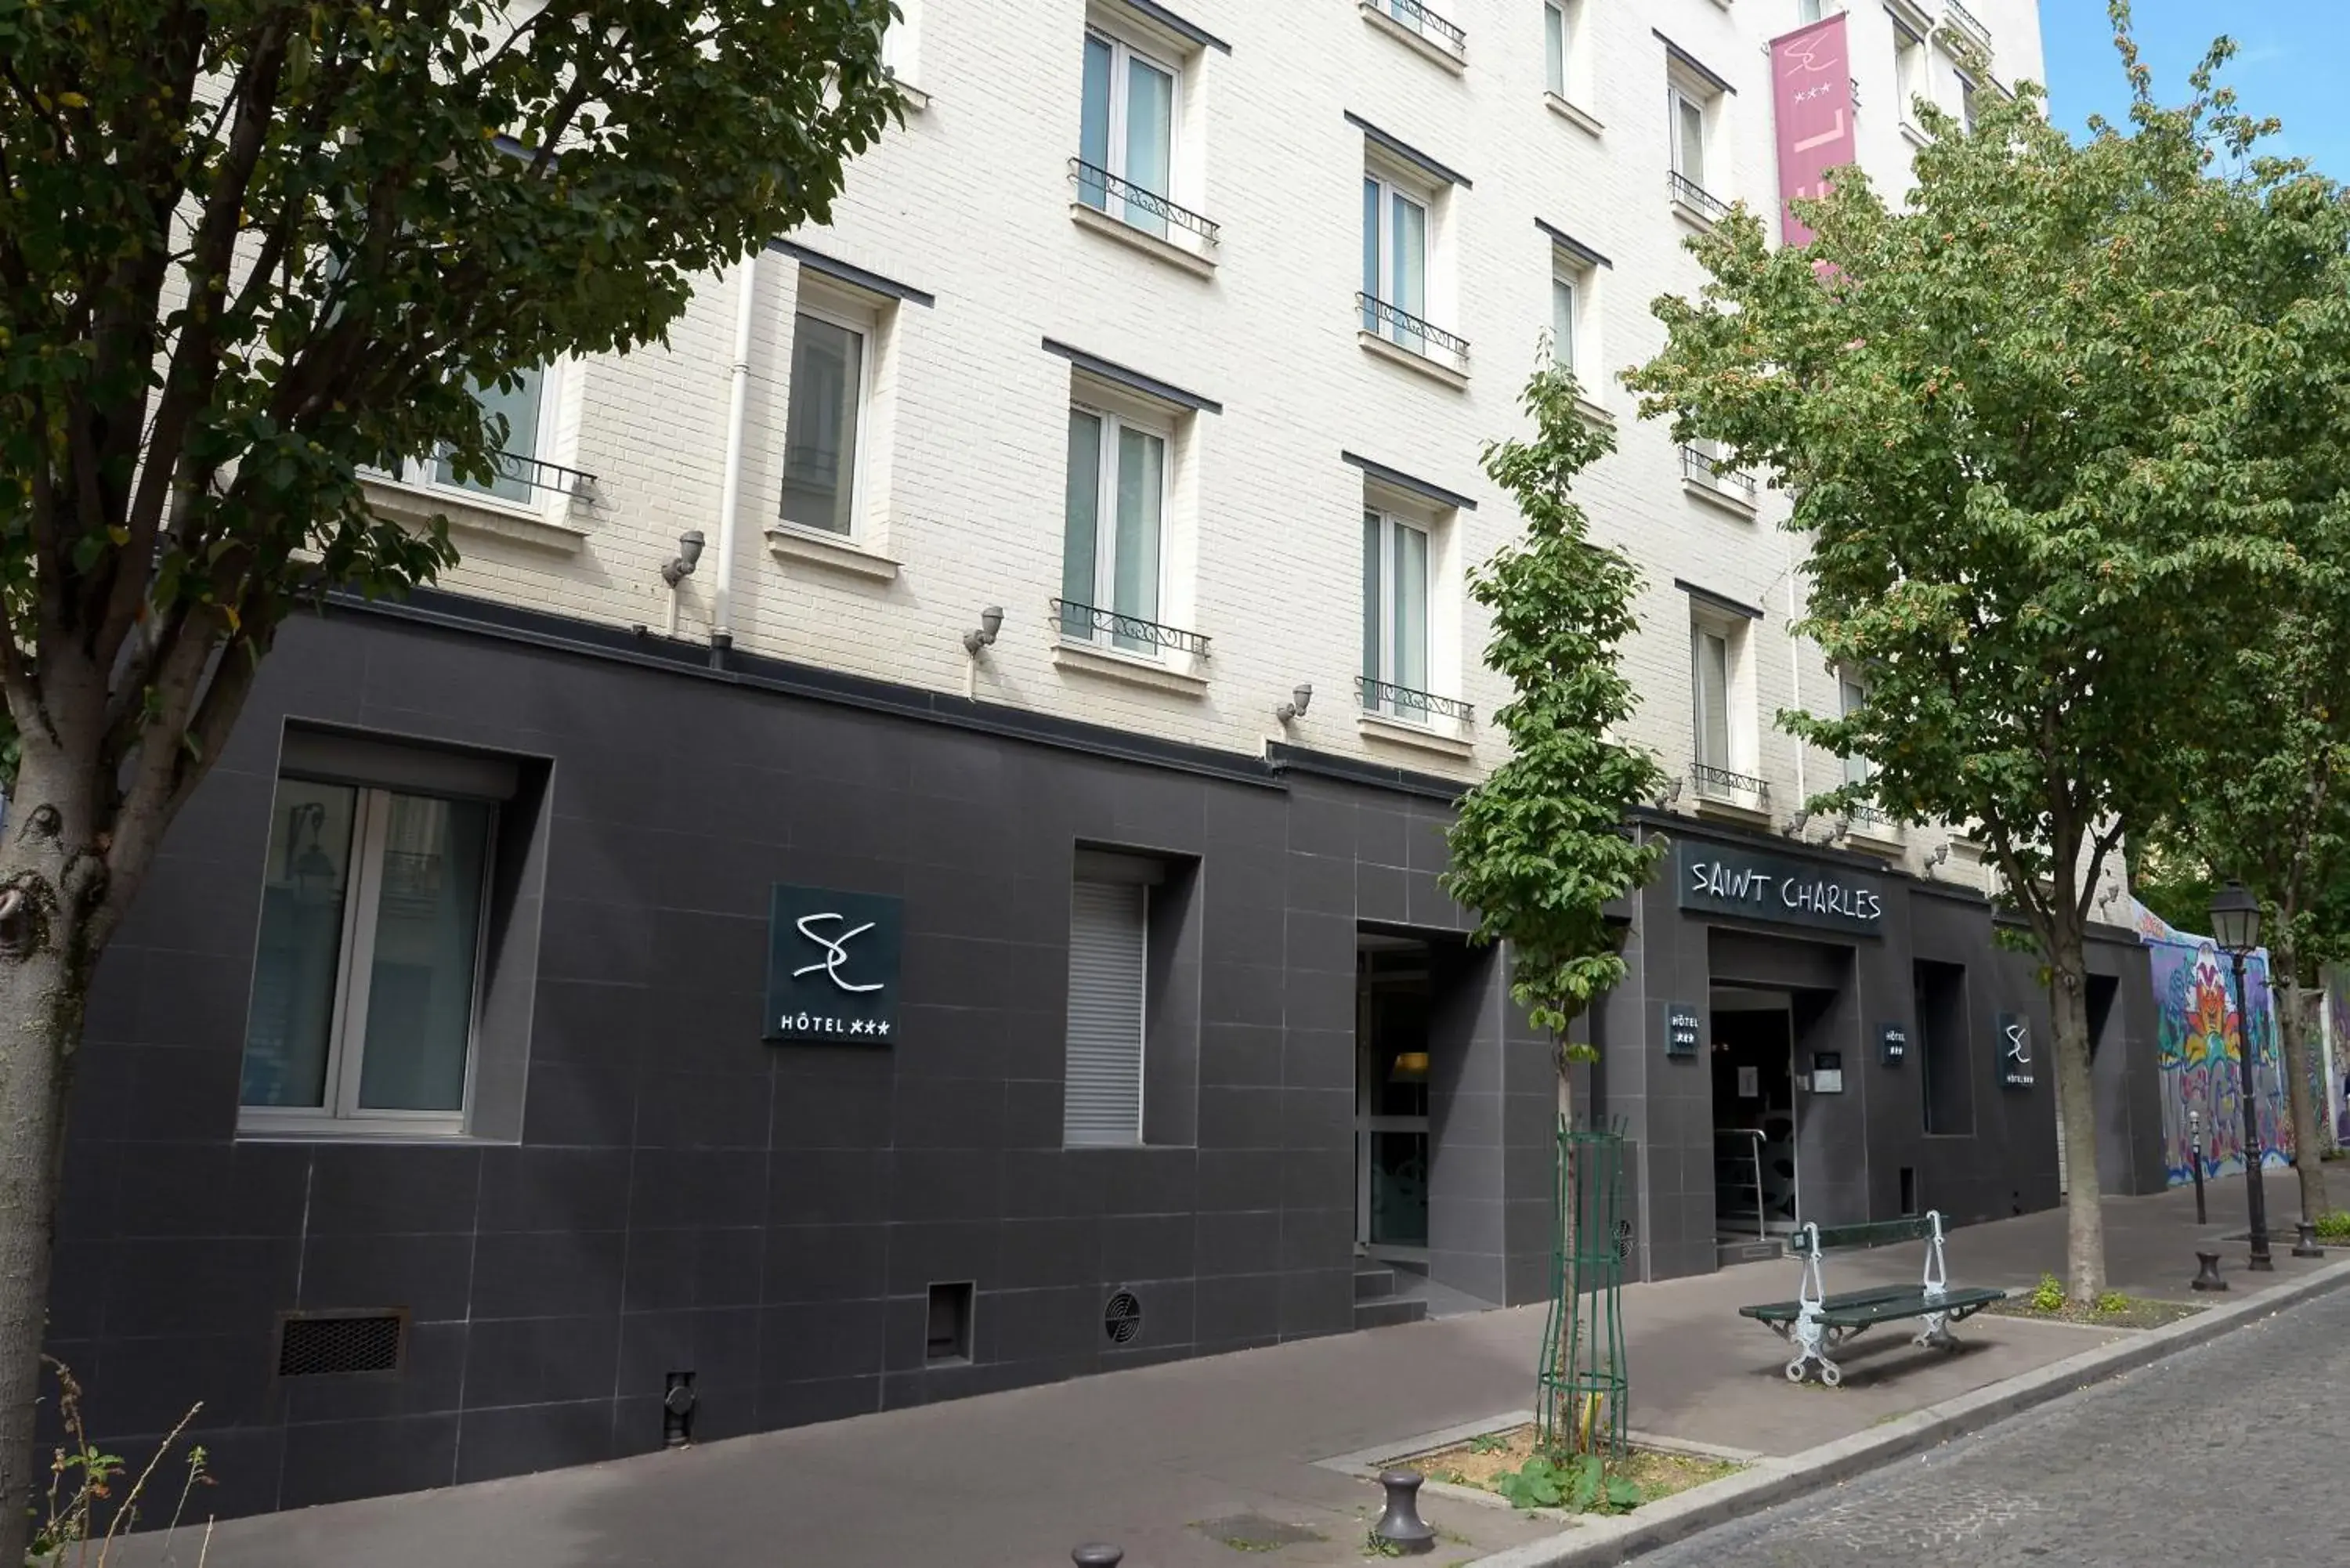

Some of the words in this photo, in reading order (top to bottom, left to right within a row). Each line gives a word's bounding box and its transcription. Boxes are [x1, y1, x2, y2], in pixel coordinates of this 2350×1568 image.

[1690, 862, 1772, 901] SAINT
[1781, 877, 1882, 919] CHARLES
[781, 1011, 844, 1033] HÔTEL
[1672, 1014, 1699, 1028] HÔTEL
